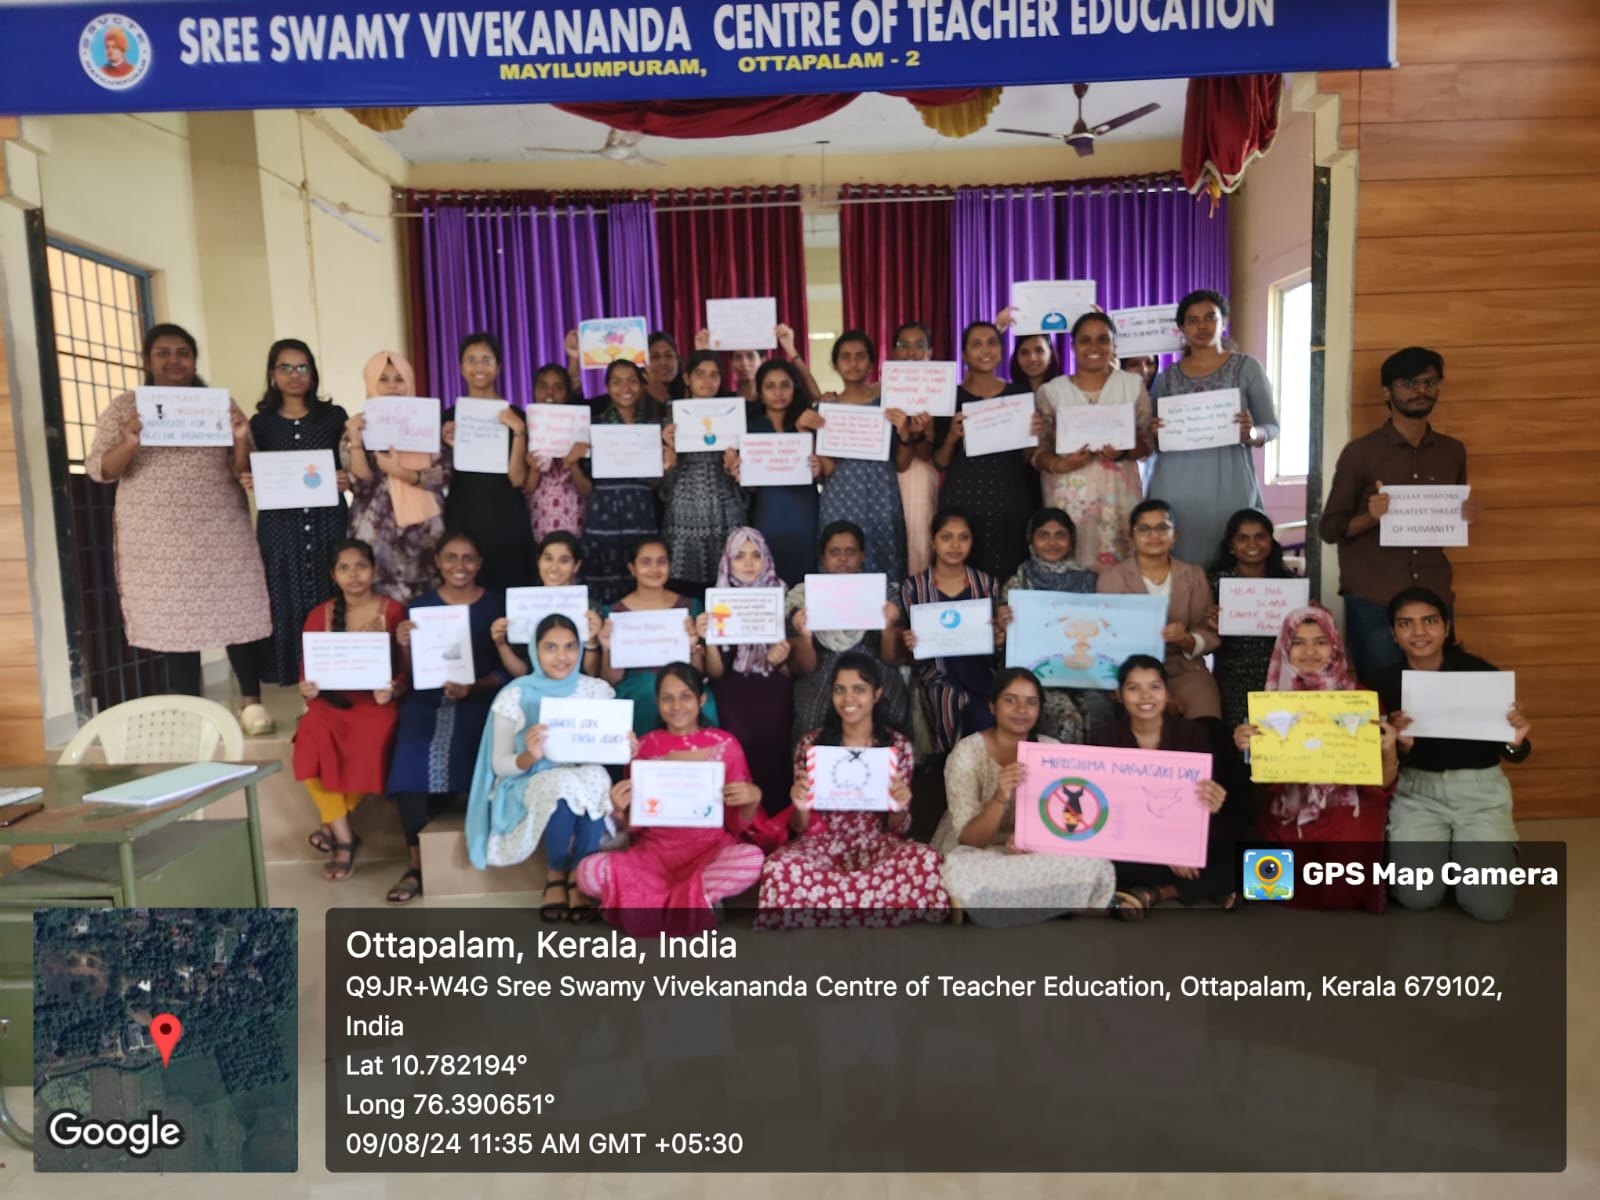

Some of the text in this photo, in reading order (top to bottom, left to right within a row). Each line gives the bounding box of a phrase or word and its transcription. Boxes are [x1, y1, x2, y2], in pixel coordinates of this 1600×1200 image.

[179, 0, 1275, 65] SREE SWAMY VIVEKANANDA CENTRE OF TEACHER EDUCATION
[499, 58, 707, 80] MAYILUMPURAM,
[737, 52, 885, 74] OTTAPALAM
[905, 50, 920, 66] 2
